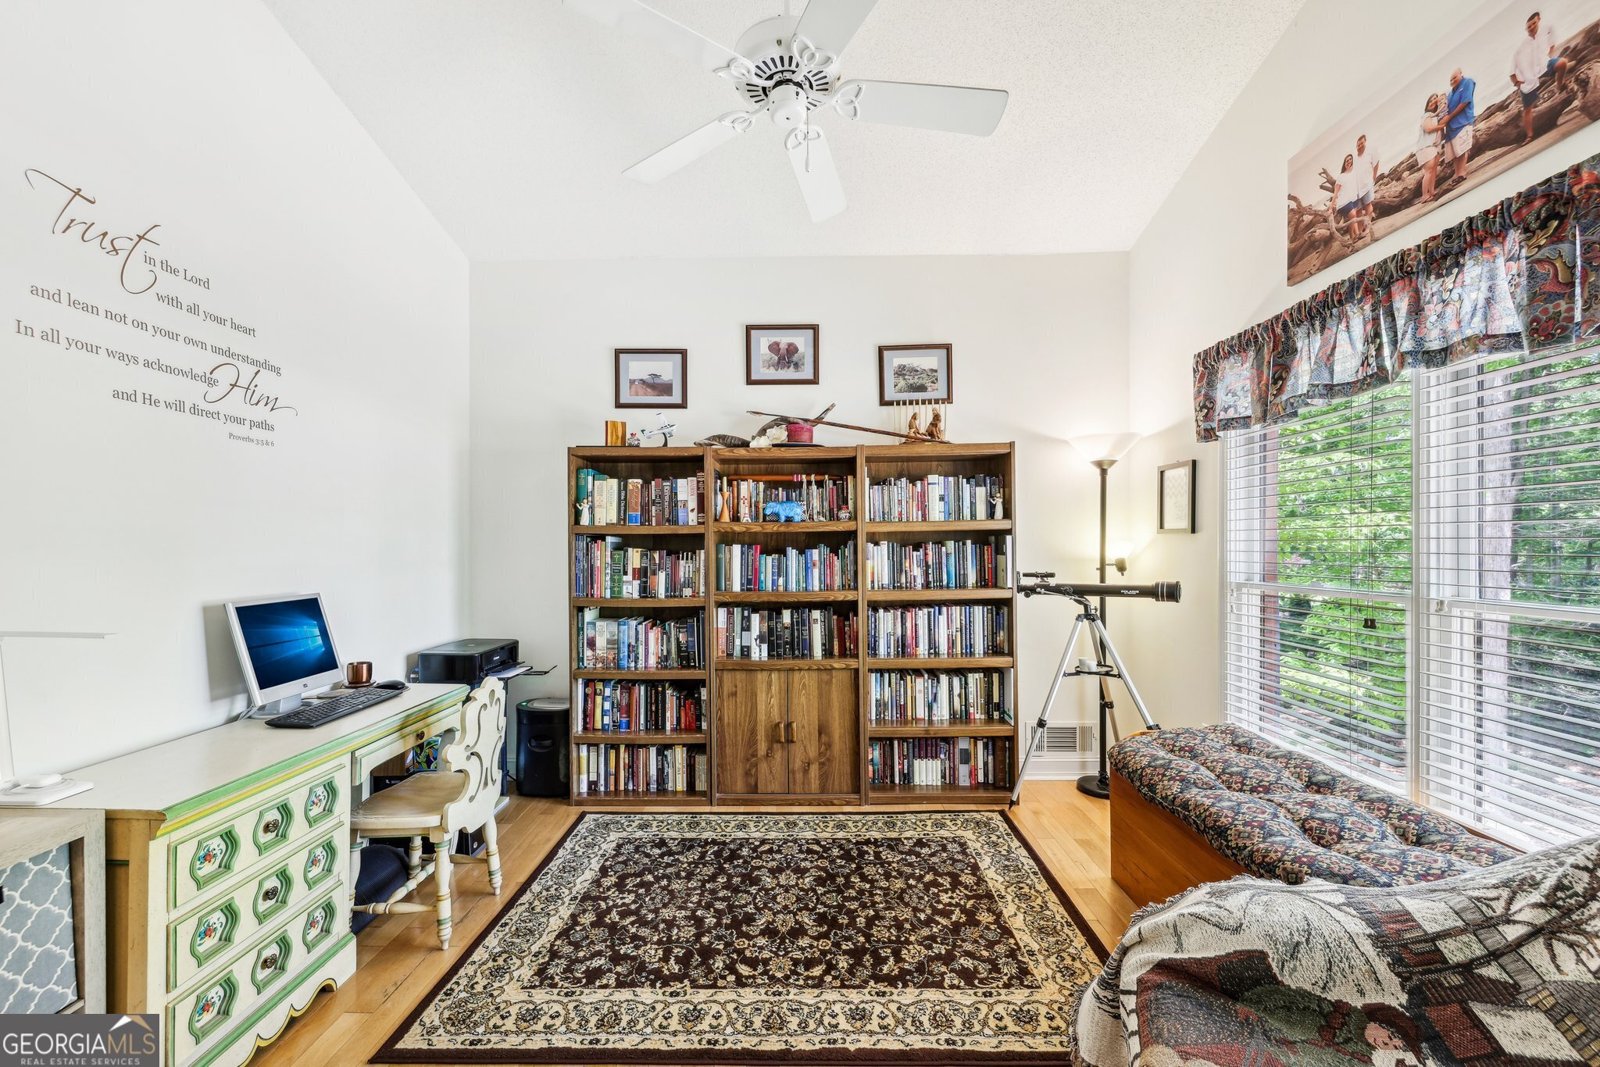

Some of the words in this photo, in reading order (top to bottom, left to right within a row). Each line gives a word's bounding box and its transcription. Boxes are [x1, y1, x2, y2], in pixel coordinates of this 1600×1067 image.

[25, 169, 161, 294] Trust
[144, 251, 157, 267] in
[160, 260, 180, 277] the
[183, 268, 211, 290] Lord
[30, 285, 63, 304] and
[67, 292, 100, 316] lean
[105, 309, 128, 325] not
[132, 319, 149, 332] on
[152, 325, 181, 341] your
[184, 336, 208, 351] own
[211, 345, 281, 377] understanding
[156, 292, 184, 310] with
[186, 303, 200, 316] all
[203, 311, 229, 327] your
[230, 317, 256, 338] heart
[16, 319, 36, 337] In
[41, 328, 60, 344] all
[65, 337, 102, 355] your
[105, 348, 139, 366] ways
[143, 358, 219, 388] acknowledge
[204, 363, 298, 416] Him
[112, 389, 137, 403] and
[142, 392, 160, 407] He
[164, 400, 185, 413] will
[189, 403, 221, 420] direct
[223, 414, 247, 426] your
[249, 419, 275, 432] paths
[229, 432, 254, 443] Proverbs
